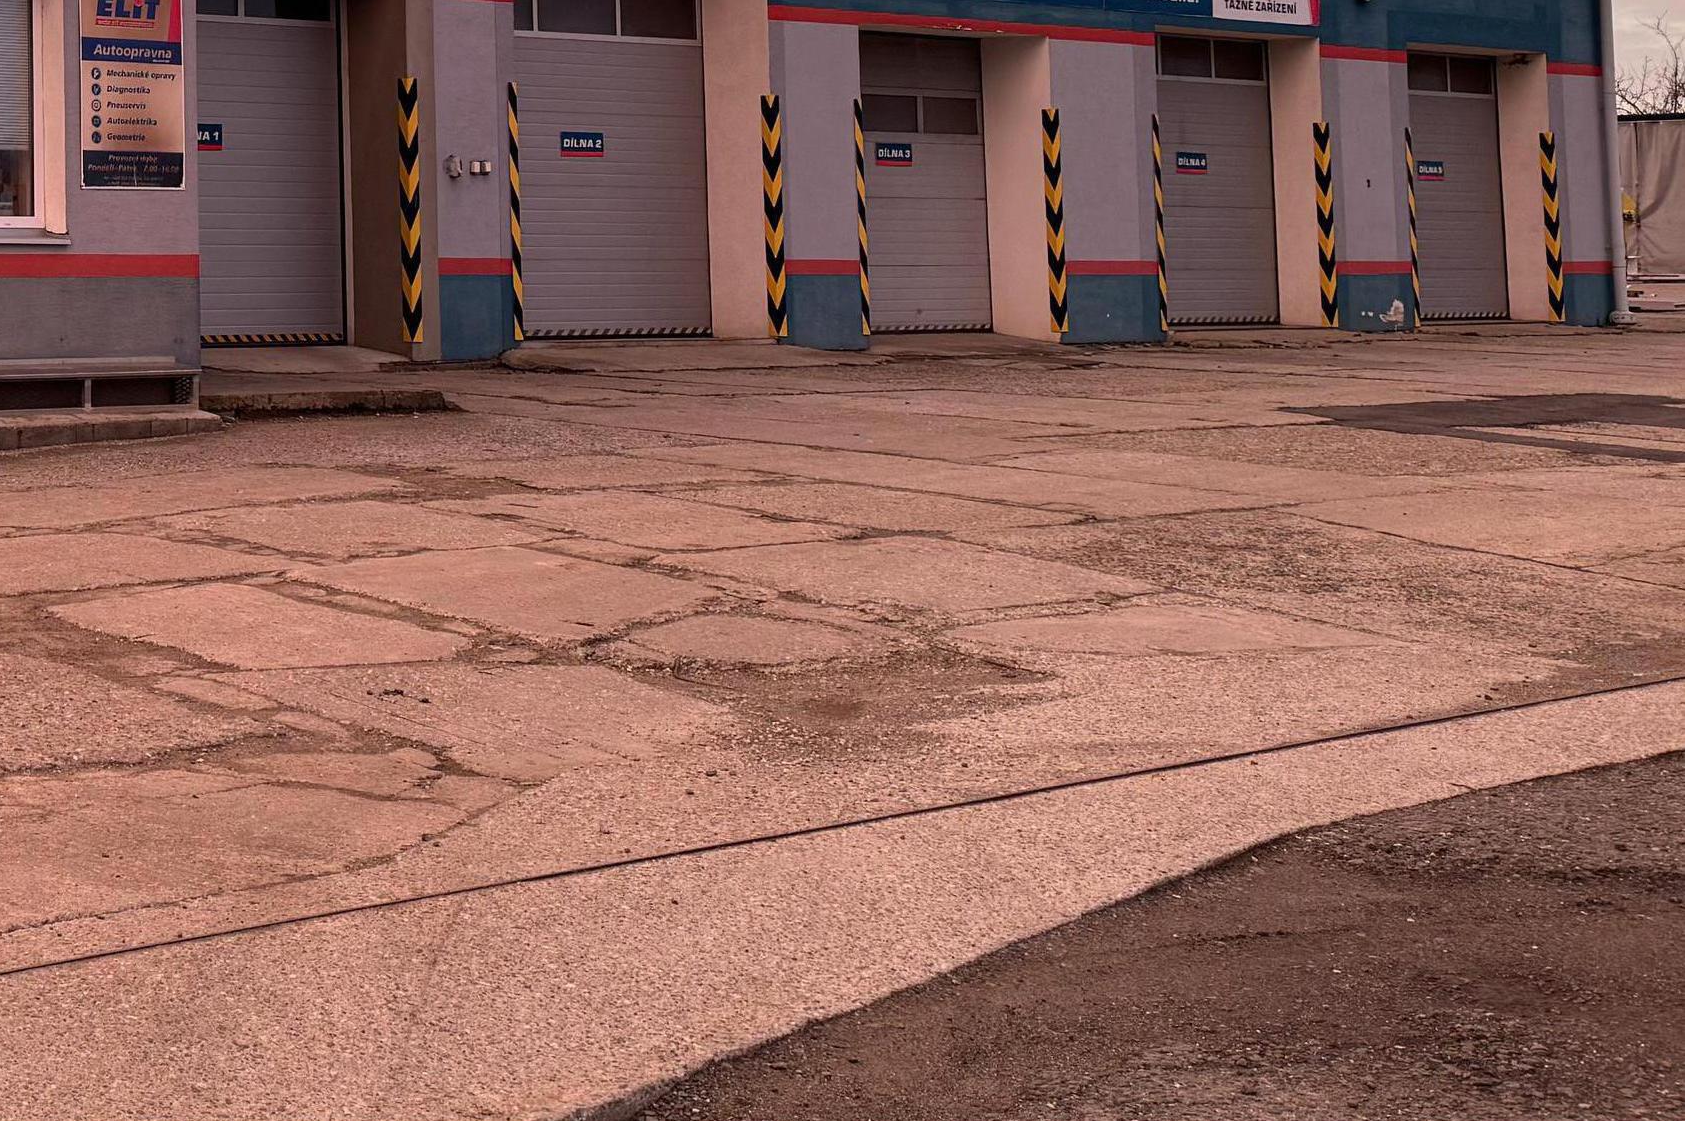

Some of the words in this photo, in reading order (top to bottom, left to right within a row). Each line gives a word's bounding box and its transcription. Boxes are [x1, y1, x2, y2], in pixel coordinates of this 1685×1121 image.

[1255, 0, 1297, 15] ZAŘÍZENÍ
[93, 43, 172, 60] Autoopravna
[106, 68, 150, 79] Mechanické
[150, 72, 176, 81] opravy
[106, 84, 151, 95] Diagnostika
[106, 100, 147, 110] Pneuservis
[106, 116, 158, 127] Autoelektrika
[106, 131, 146, 142] Geometrie
[213, 131, 219, 141] 1
[563, 136, 594, 148] DÍLNA
[595, 139, 602, 149] 2
[878, 146, 904, 158] DÍLNA
[904, 149, 911, 158] 3
[1178, 156, 1200, 166] DÍLNA
[1200, 158, 1206, 167] 4
